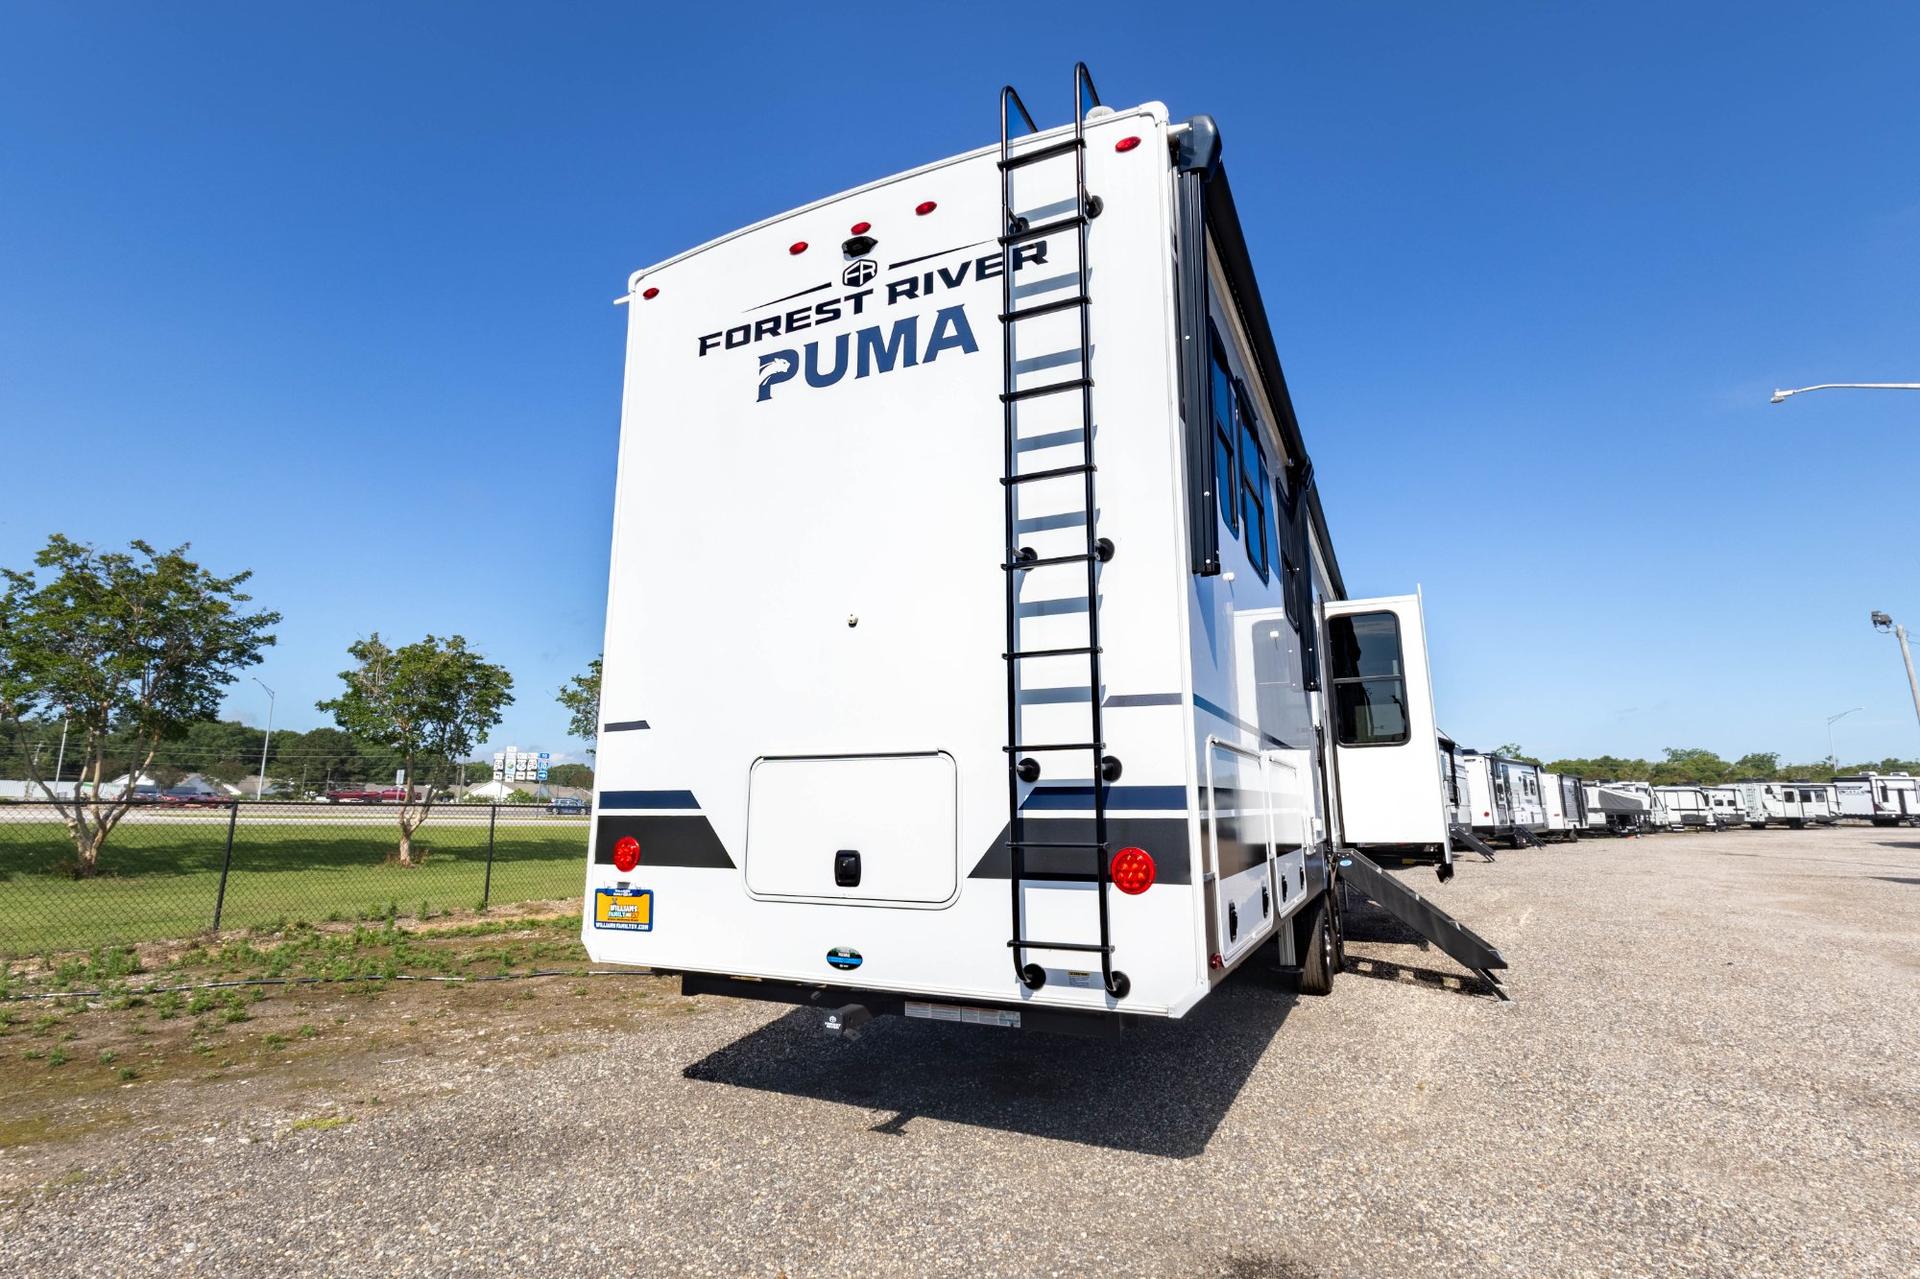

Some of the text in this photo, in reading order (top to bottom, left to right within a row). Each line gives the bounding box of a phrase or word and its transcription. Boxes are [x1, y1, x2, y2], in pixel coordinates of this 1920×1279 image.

[697, 240, 1049, 357] FOREST RIVER
[756, 303, 980, 403] PUMA
